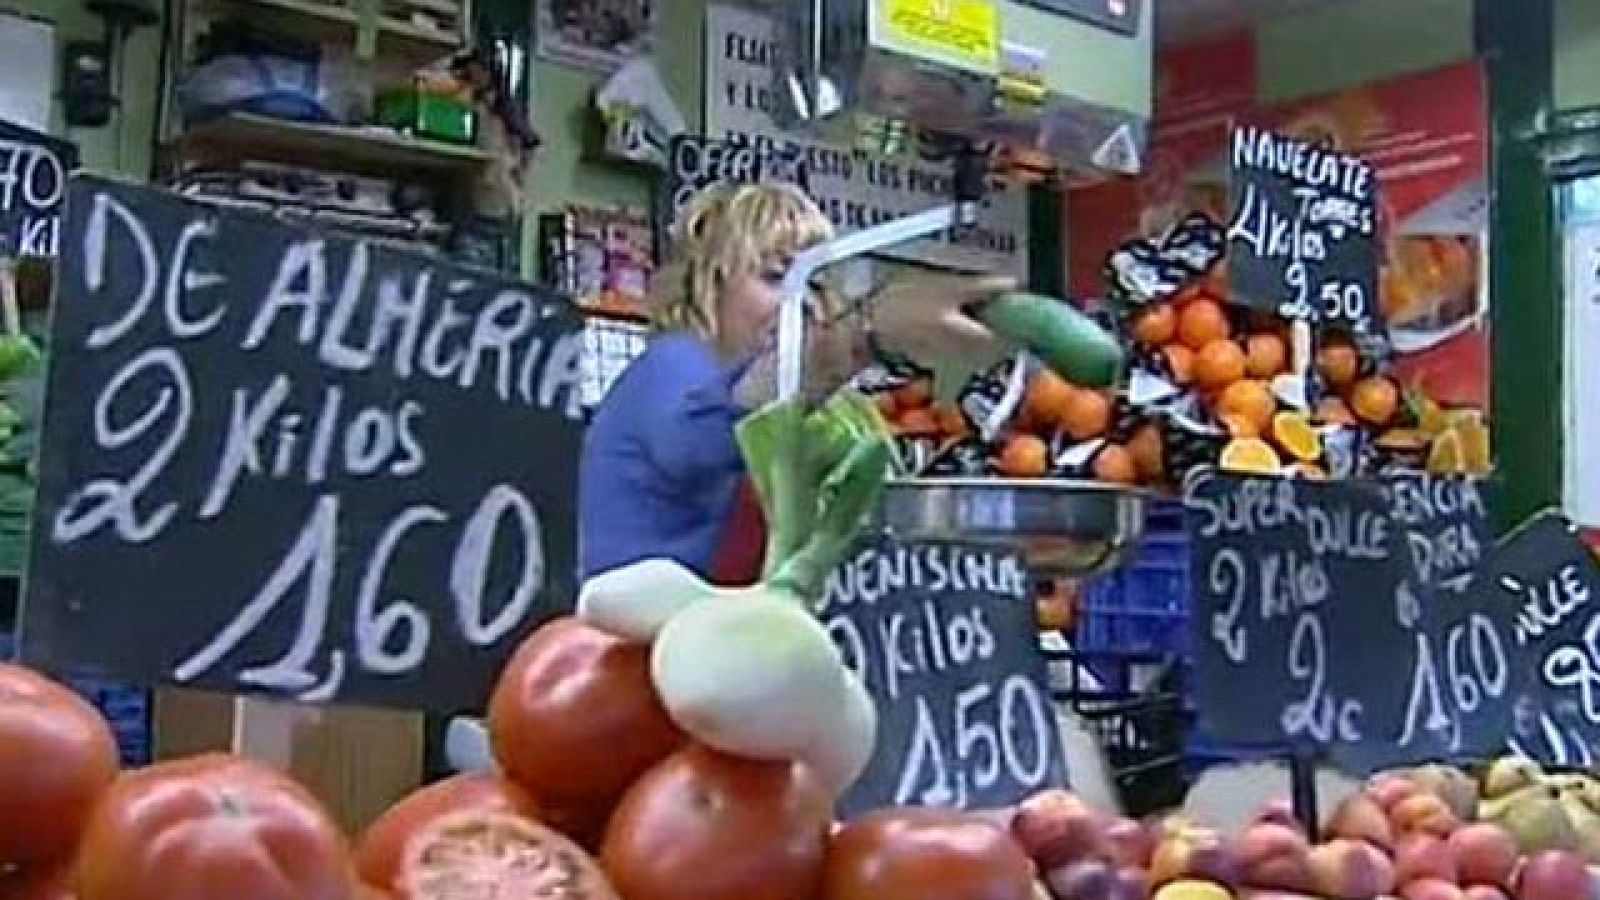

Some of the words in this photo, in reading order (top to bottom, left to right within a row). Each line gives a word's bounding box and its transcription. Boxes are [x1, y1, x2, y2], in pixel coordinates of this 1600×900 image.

[84, 193, 227, 346] DE
[52, 347, 192, 544] 2
[199, 374, 427, 517] Kilos
[174, 484, 544, 701] 1,60
[879, 600, 995, 698] Kilos
[1210, 548, 1246, 664] 2
[895, 675, 1049, 809] 1,50
